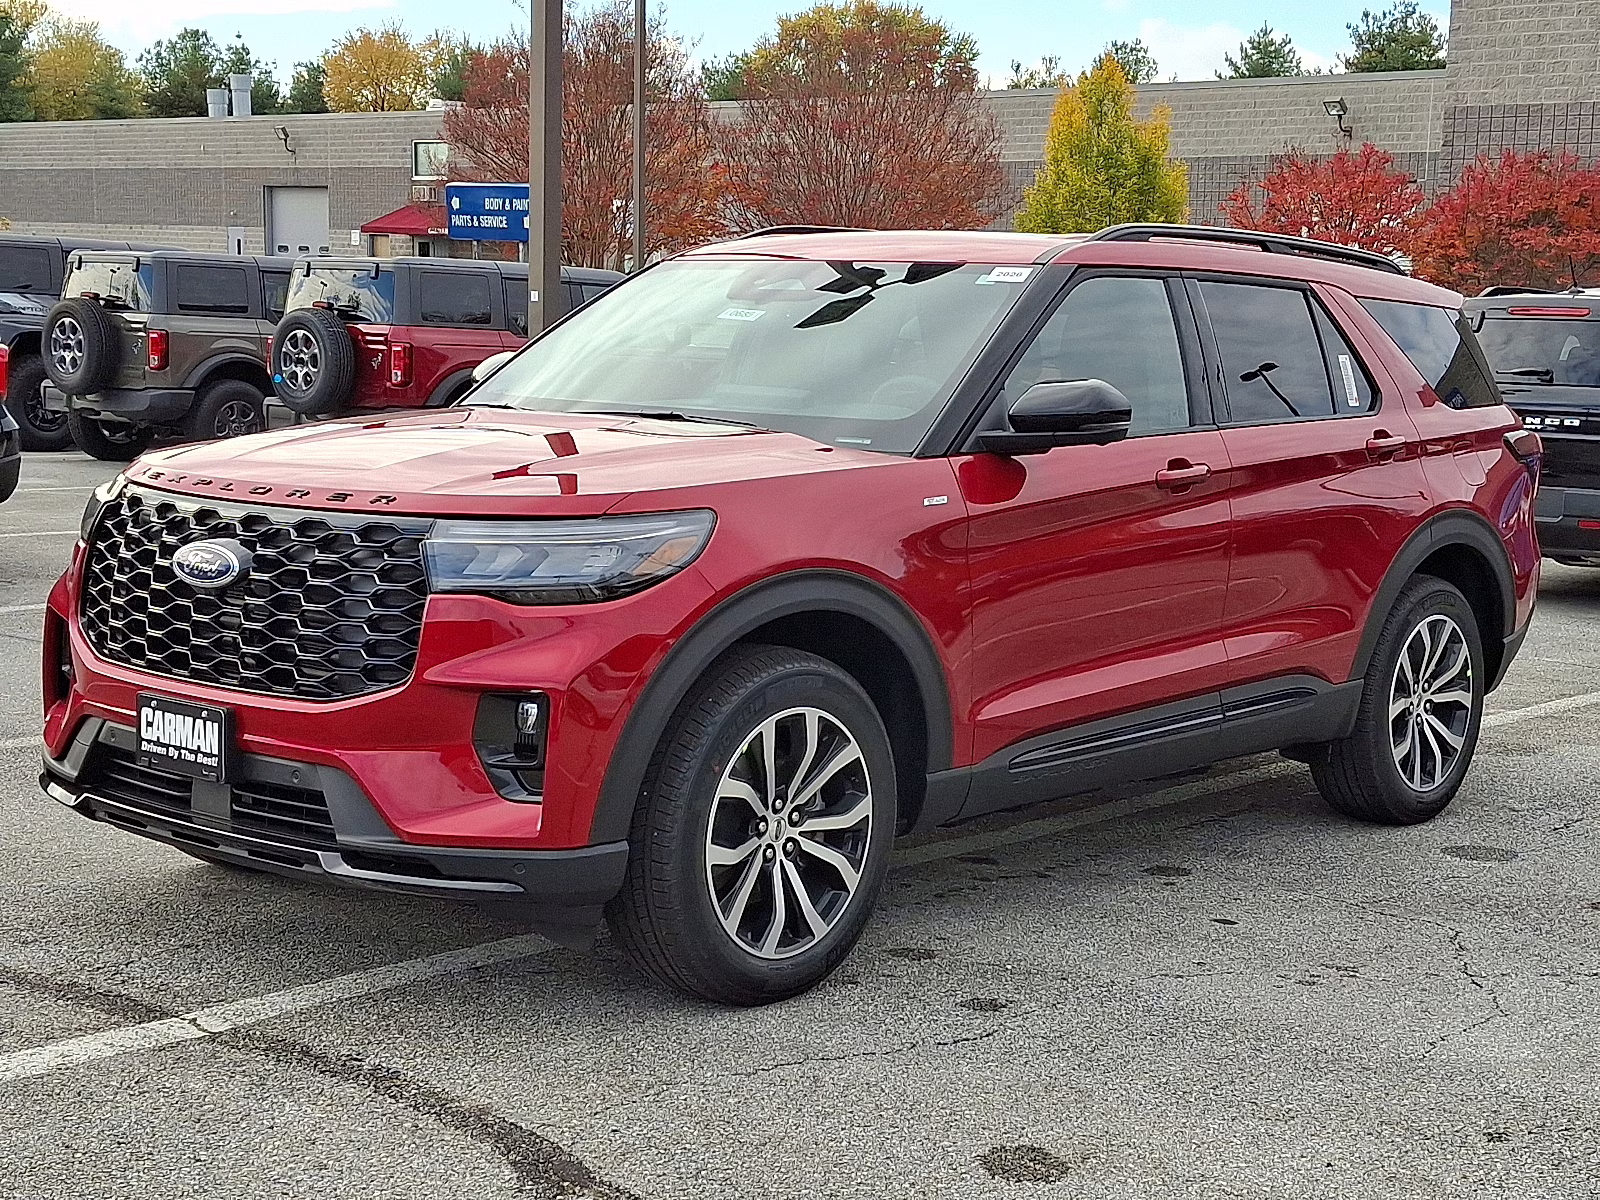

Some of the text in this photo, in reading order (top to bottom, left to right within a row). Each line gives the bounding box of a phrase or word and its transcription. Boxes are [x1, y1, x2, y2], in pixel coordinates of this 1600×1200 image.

[485, 197, 503, 211] BODY
[505, 198, 511, 211] &
[451, 215, 508, 228] PARTS & SERVICE
[1519, 416, 1581, 427] NCO
[147, 471, 398, 506] EXPLORER
[183, 550, 222, 577] Ford
[140, 706, 219, 754] CARMAN
[141, 741, 218, 767] Driven By The Best!
